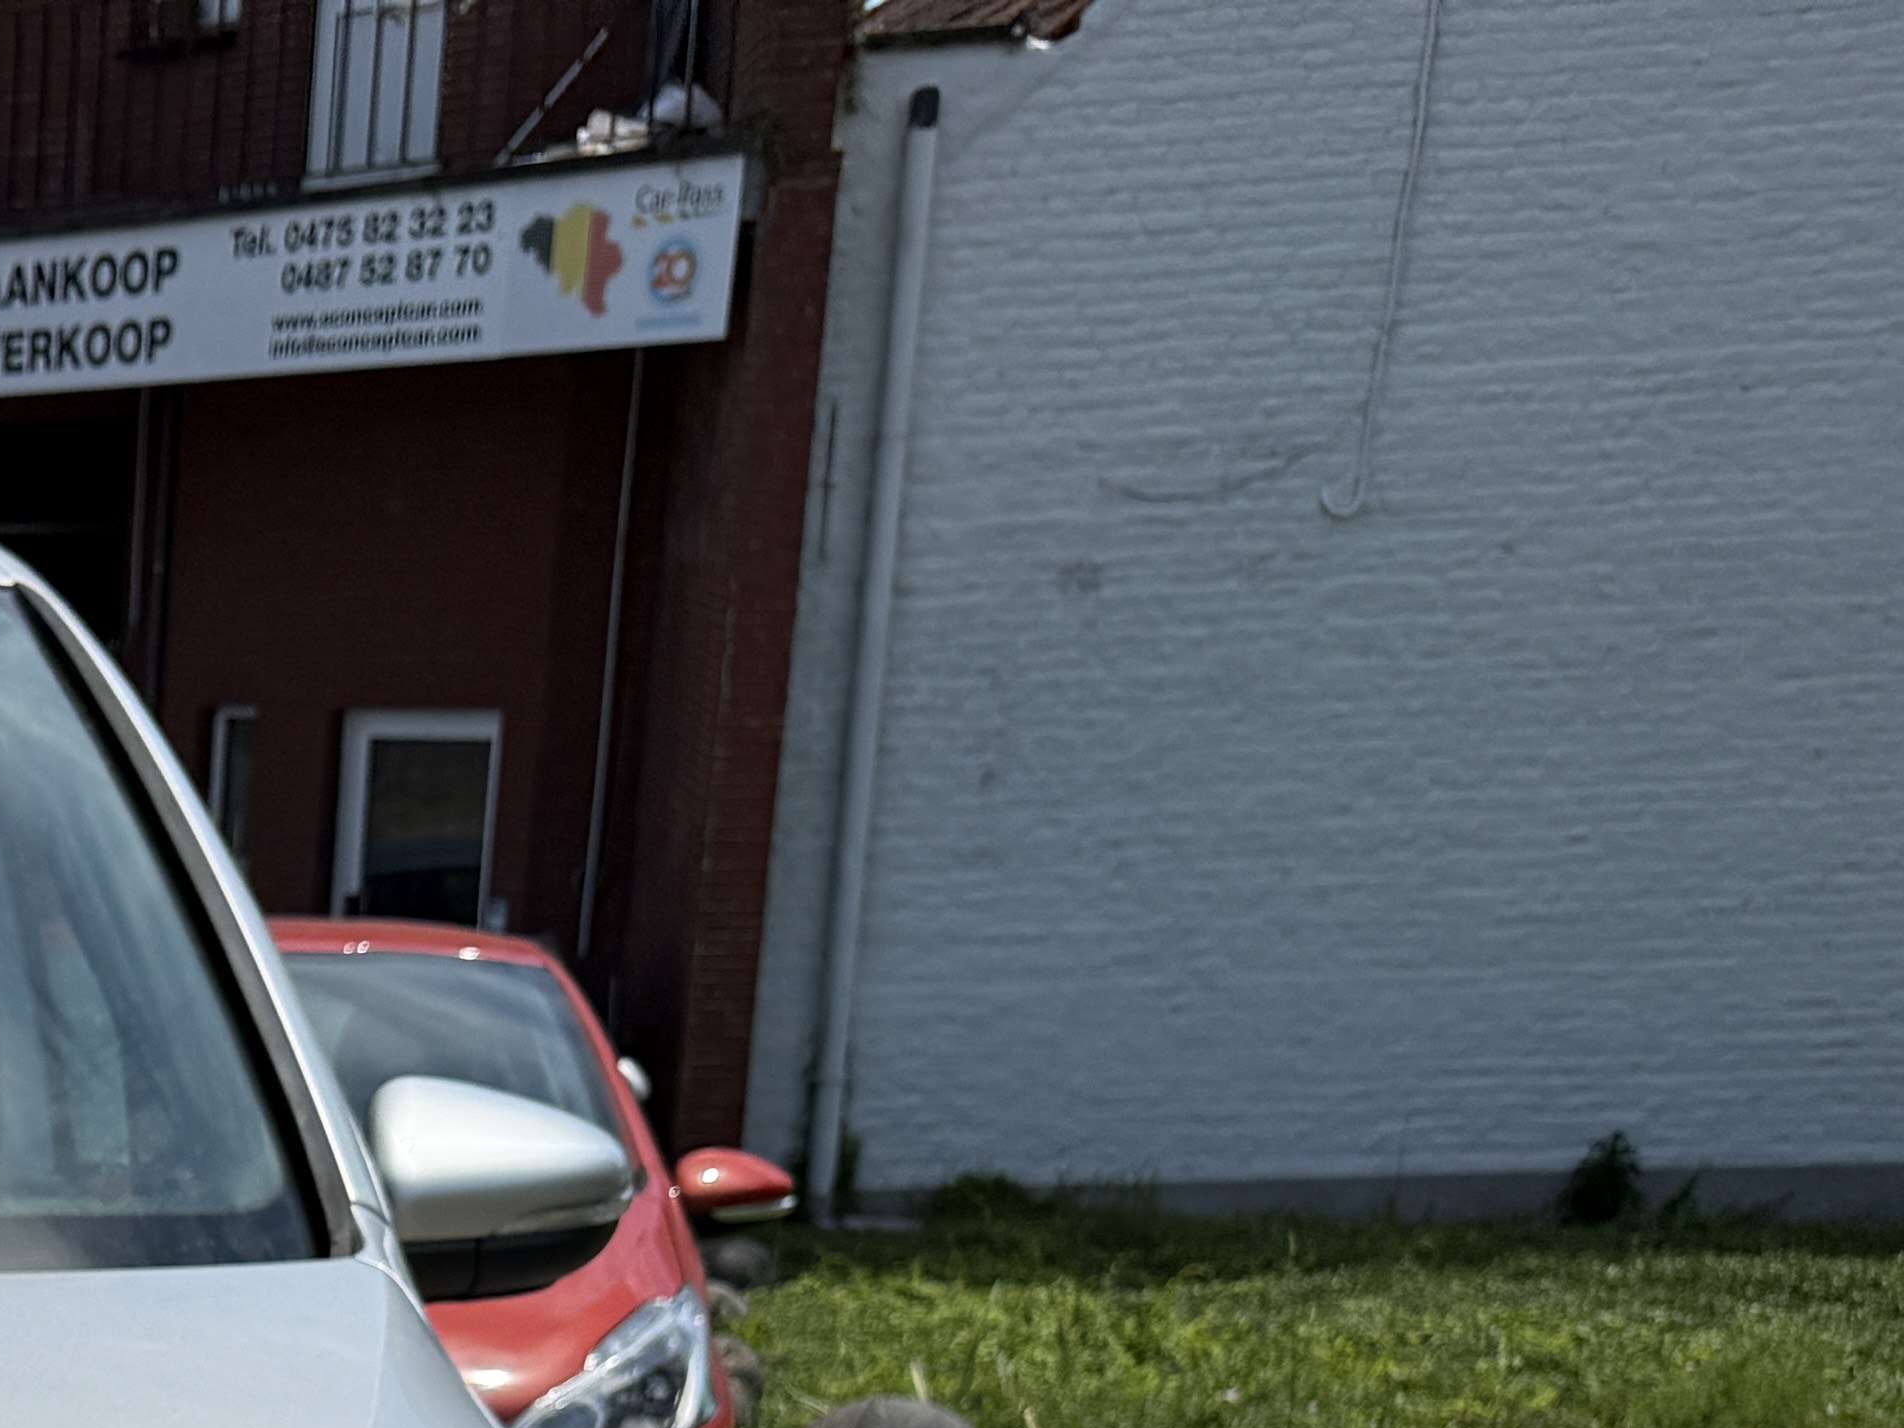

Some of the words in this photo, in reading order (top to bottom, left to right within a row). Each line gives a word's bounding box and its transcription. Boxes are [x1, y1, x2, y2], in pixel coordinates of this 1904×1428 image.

[230, 224, 275, 260] Tel.
[283, 215, 354, 255] 0475
[362, 208, 401, 245] 82
[407, 204, 447, 240] 32
[455, 198, 496, 236] 23
[280, 254, 352, 295] 0487
[358, 249, 397, 287] 52
[405, 245, 442, 283] 87
[453, 240, 493, 276] 70
